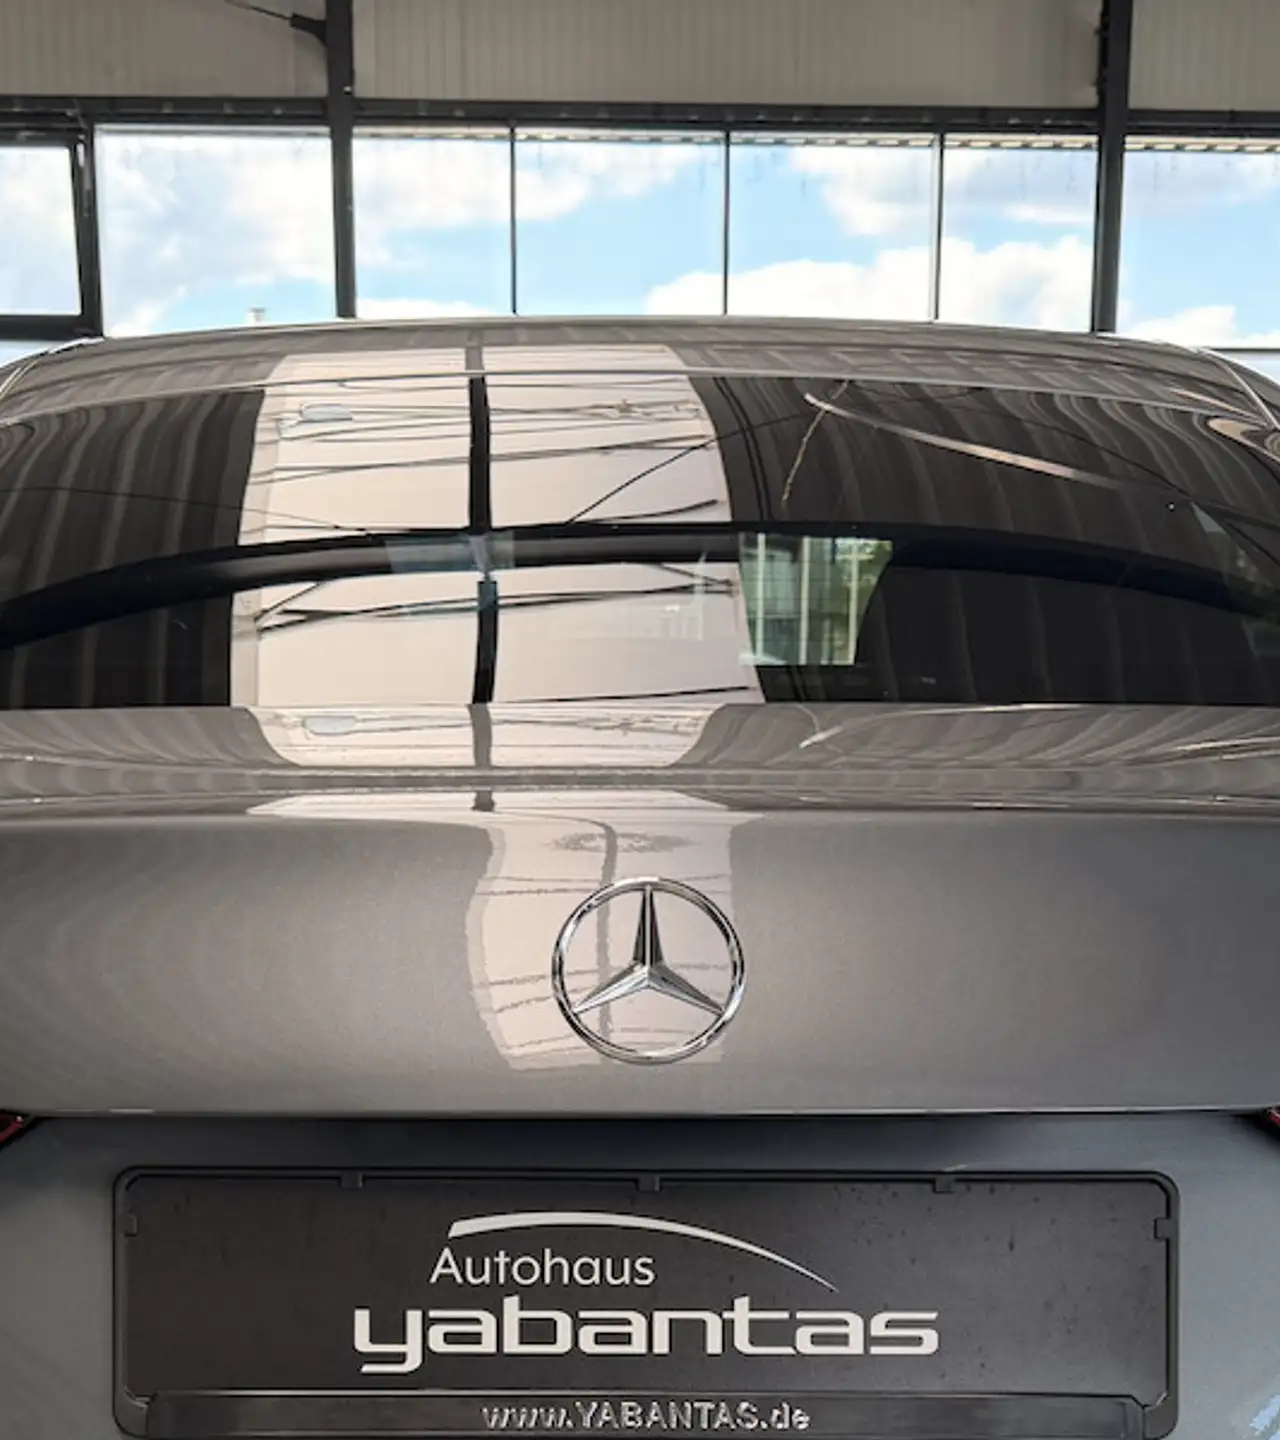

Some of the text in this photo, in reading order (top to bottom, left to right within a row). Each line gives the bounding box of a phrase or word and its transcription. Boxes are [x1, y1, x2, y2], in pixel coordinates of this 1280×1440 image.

[429, 1247, 656, 1286] Autohaus
[354, 1295, 940, 1375] yabantas
[481, 1400, 812, 1431] www.YABANTAS.de
